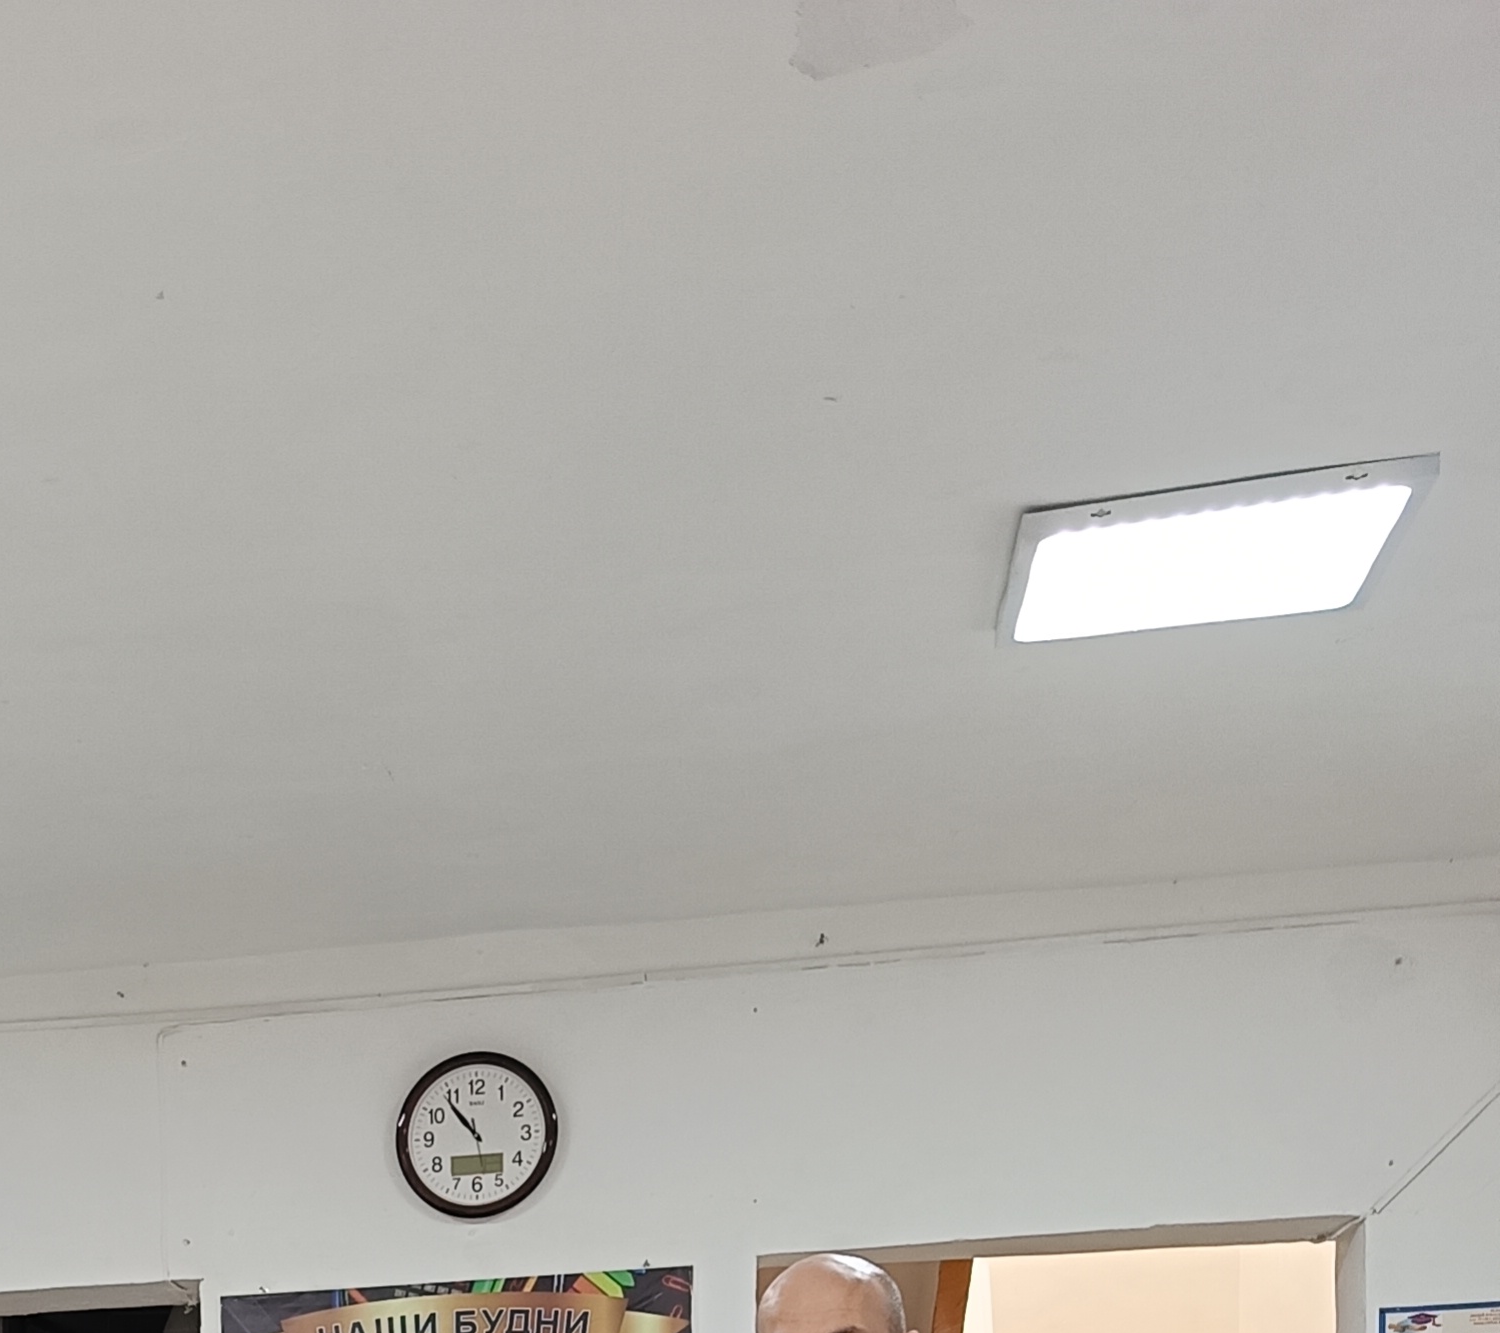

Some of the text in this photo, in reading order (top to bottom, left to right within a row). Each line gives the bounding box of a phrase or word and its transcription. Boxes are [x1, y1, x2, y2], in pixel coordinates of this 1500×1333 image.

[446, 1088, 459, 1104] 11
[468, 1079, 486, 1096] 12
[498, 1085, 504, 1101] 1
[429, 1107, 445, 1125] 10
[513, 1101, 524, 1118] 2
[423, 1131, 435, 1148] 9
[520, 1124, 532, 1141] 3
[431, 1156, 443, 1173] 8
[512, 1150, 523, 1167] 4
[452, 1177, 461, 1190] 7
[471, 1176, 483, 1193] 6
[494, 1173, 504, 1187] 5
